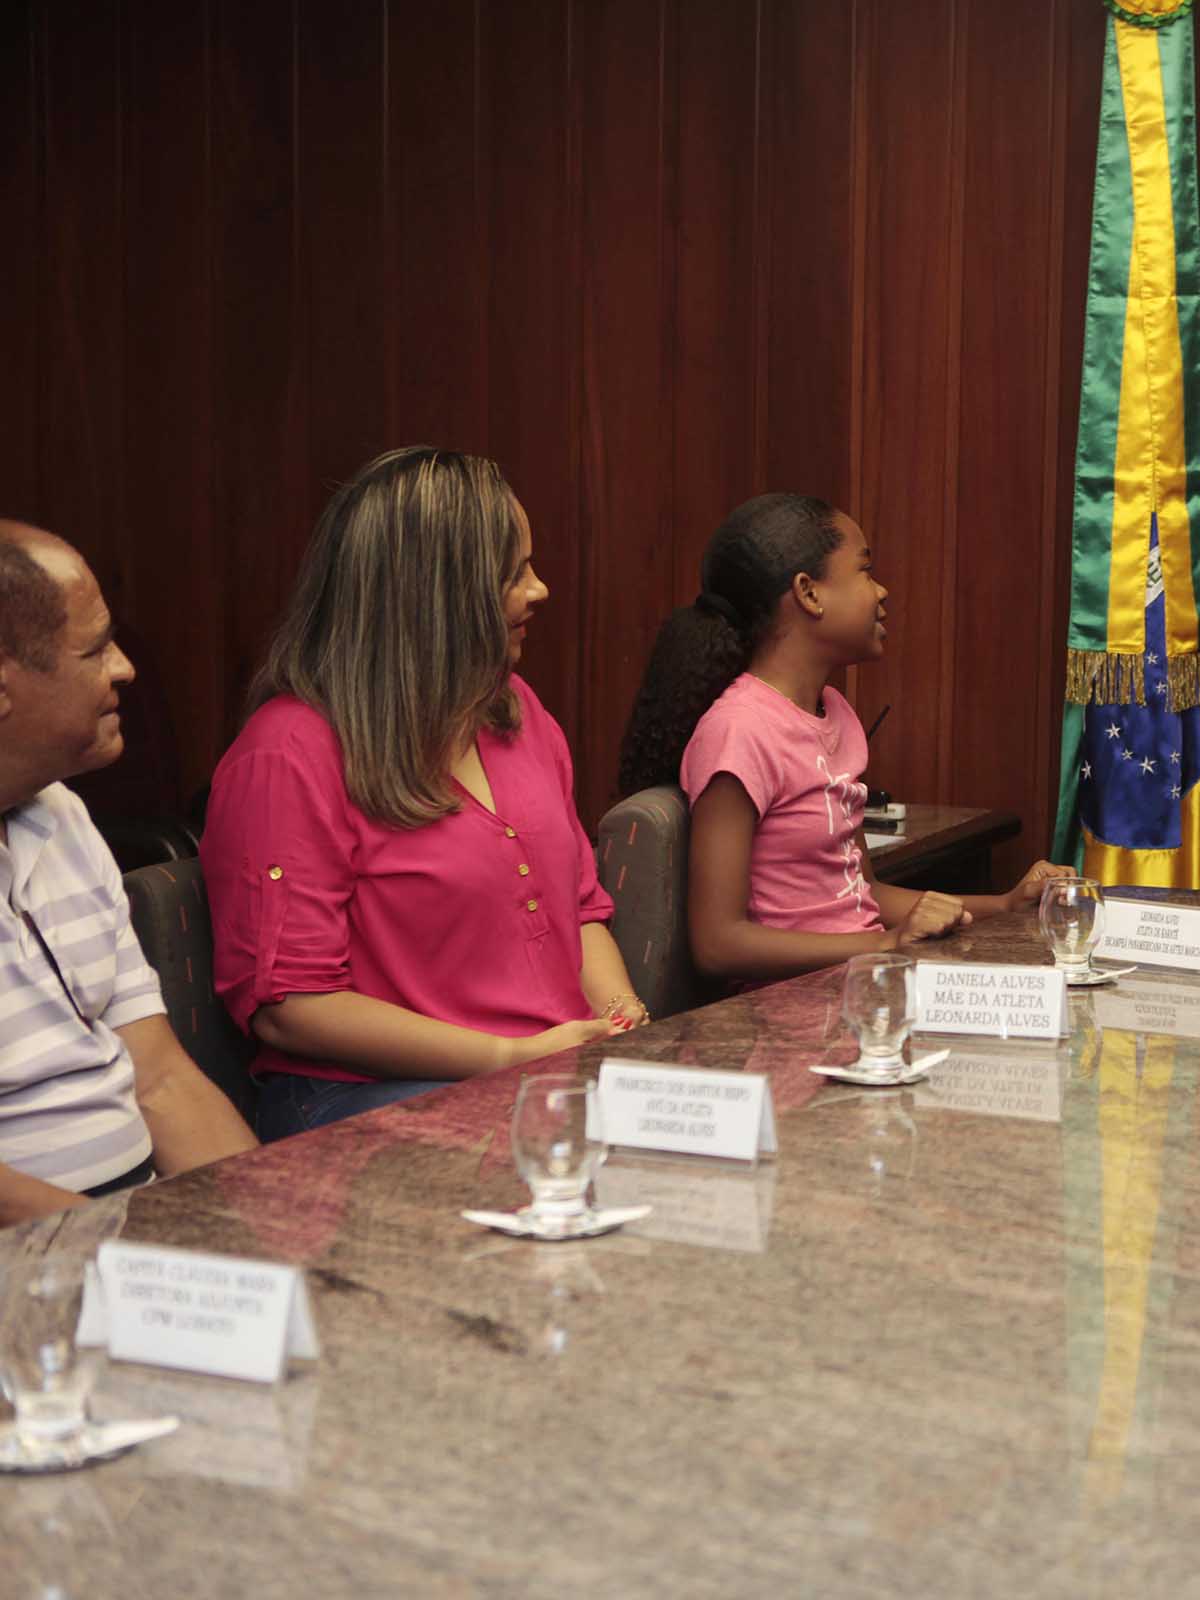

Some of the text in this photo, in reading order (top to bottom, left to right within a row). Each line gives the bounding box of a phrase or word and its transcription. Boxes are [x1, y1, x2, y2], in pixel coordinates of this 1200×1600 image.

[936, 972, 1045, 989] DANIELA ALVES
[969, 994, 988, 1006] DA
[992, 995, 1044, 1008] ATLETA
[925, 1010, 1050, 1027] LEONARDA ALVES
